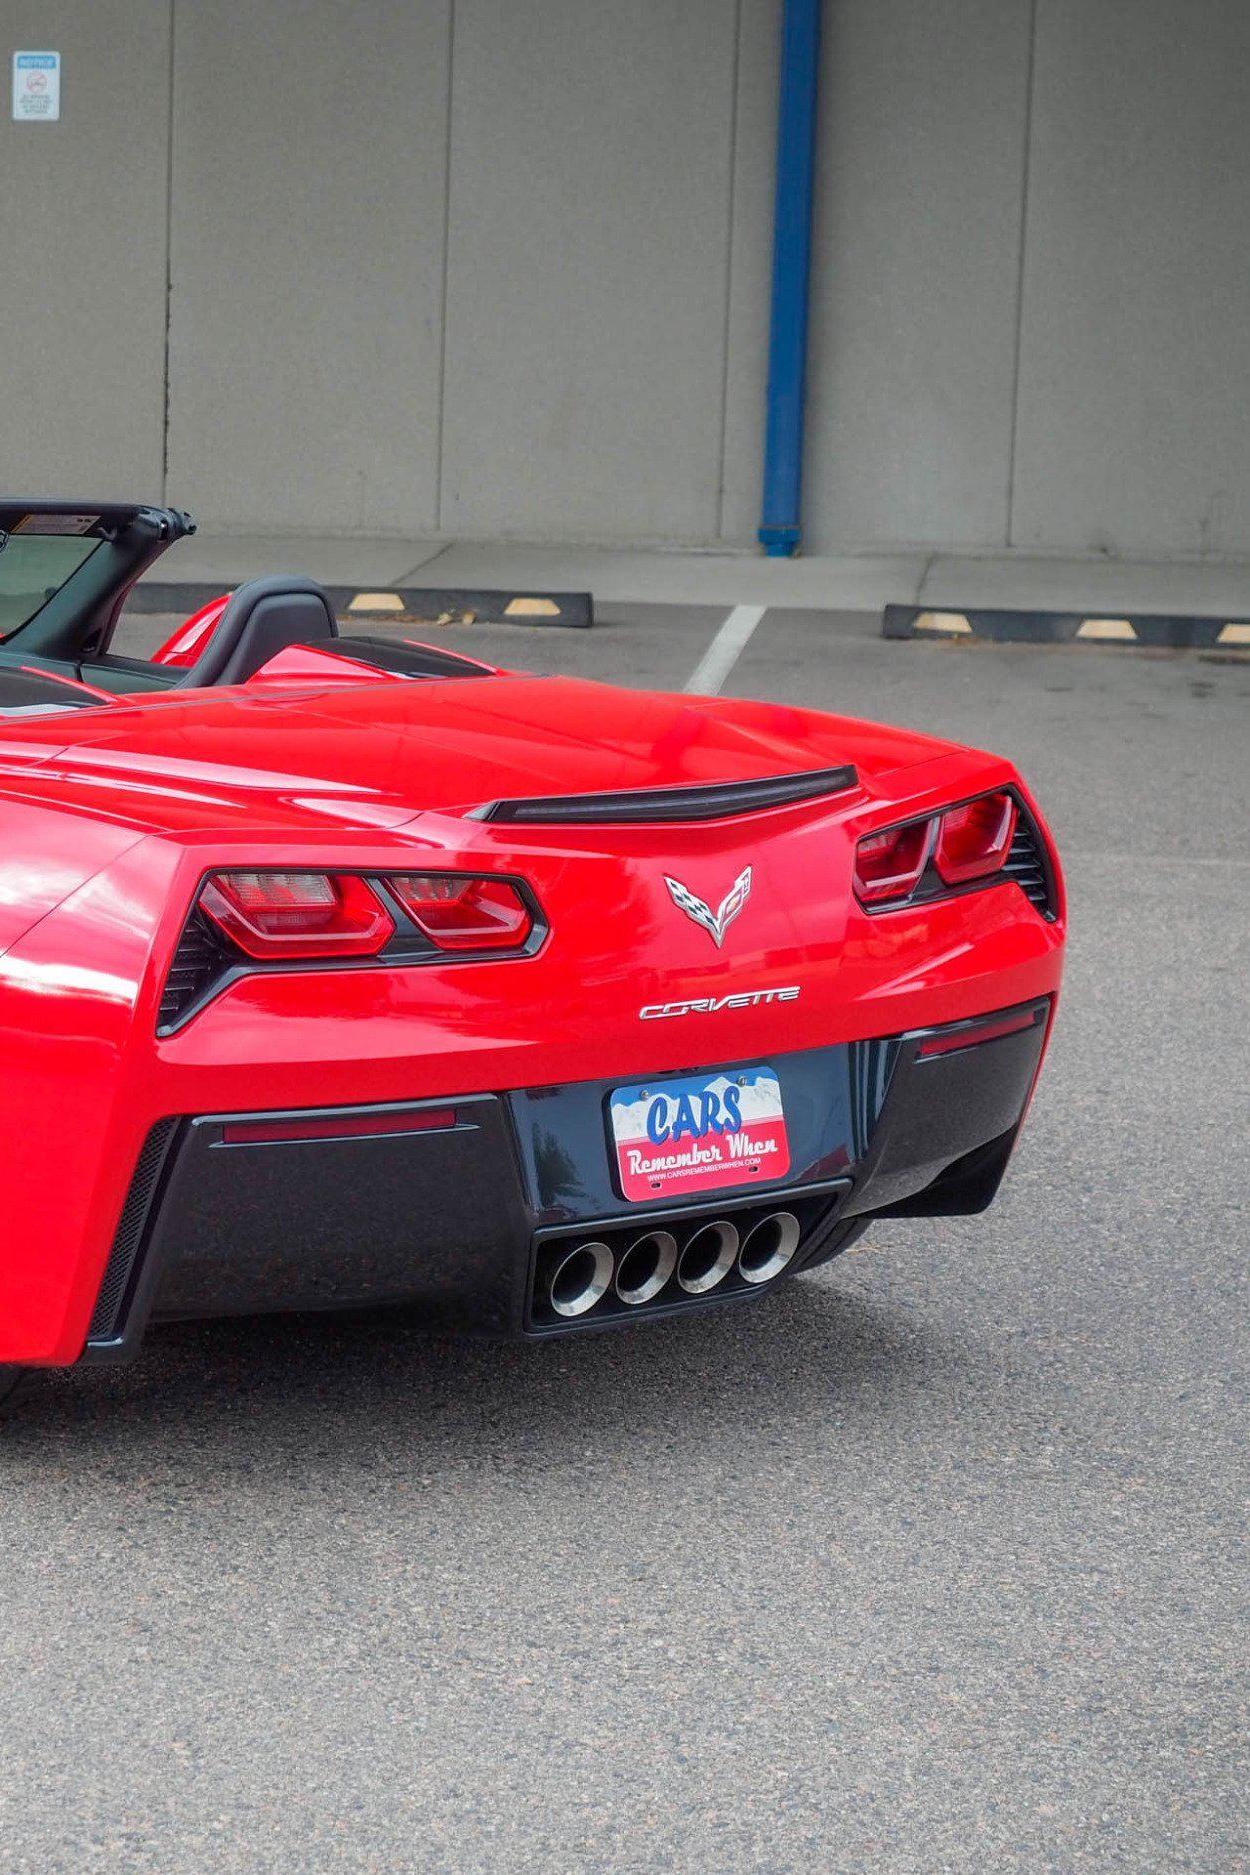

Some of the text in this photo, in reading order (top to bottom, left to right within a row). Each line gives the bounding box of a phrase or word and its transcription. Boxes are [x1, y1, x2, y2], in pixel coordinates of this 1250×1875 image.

[639, 986, 801, 1020] CORVETTE
[647, 1085, 742, 1145] CARS
[627, 1133, 778, 1175] Remember When
